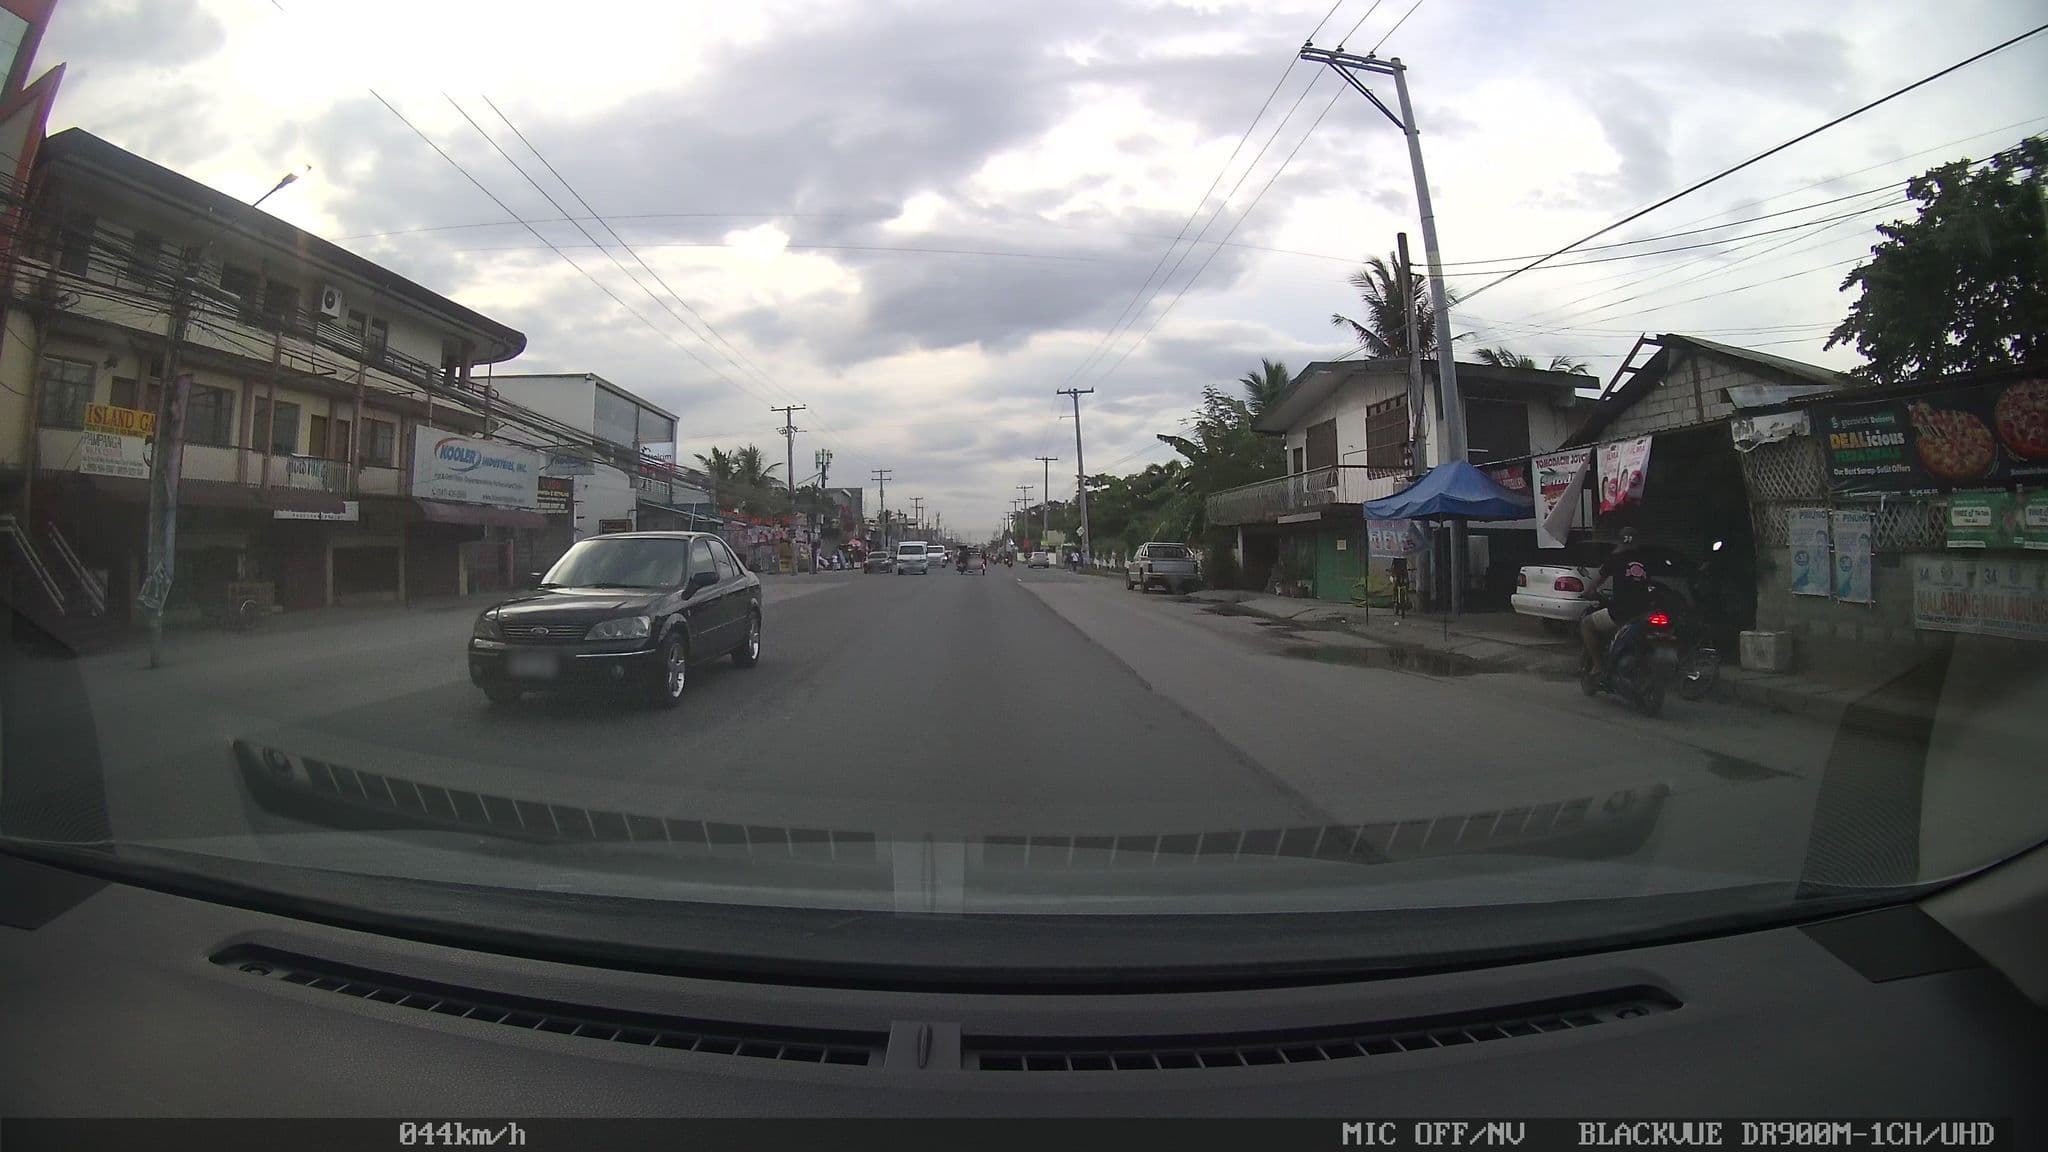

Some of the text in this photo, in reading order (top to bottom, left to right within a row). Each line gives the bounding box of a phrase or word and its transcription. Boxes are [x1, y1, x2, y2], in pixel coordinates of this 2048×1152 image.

[87, 405, 134, 428] ISLAND
[1830, 429, 1905, 449] DEALicious
[439, 445, 477, 464] KOOLER
